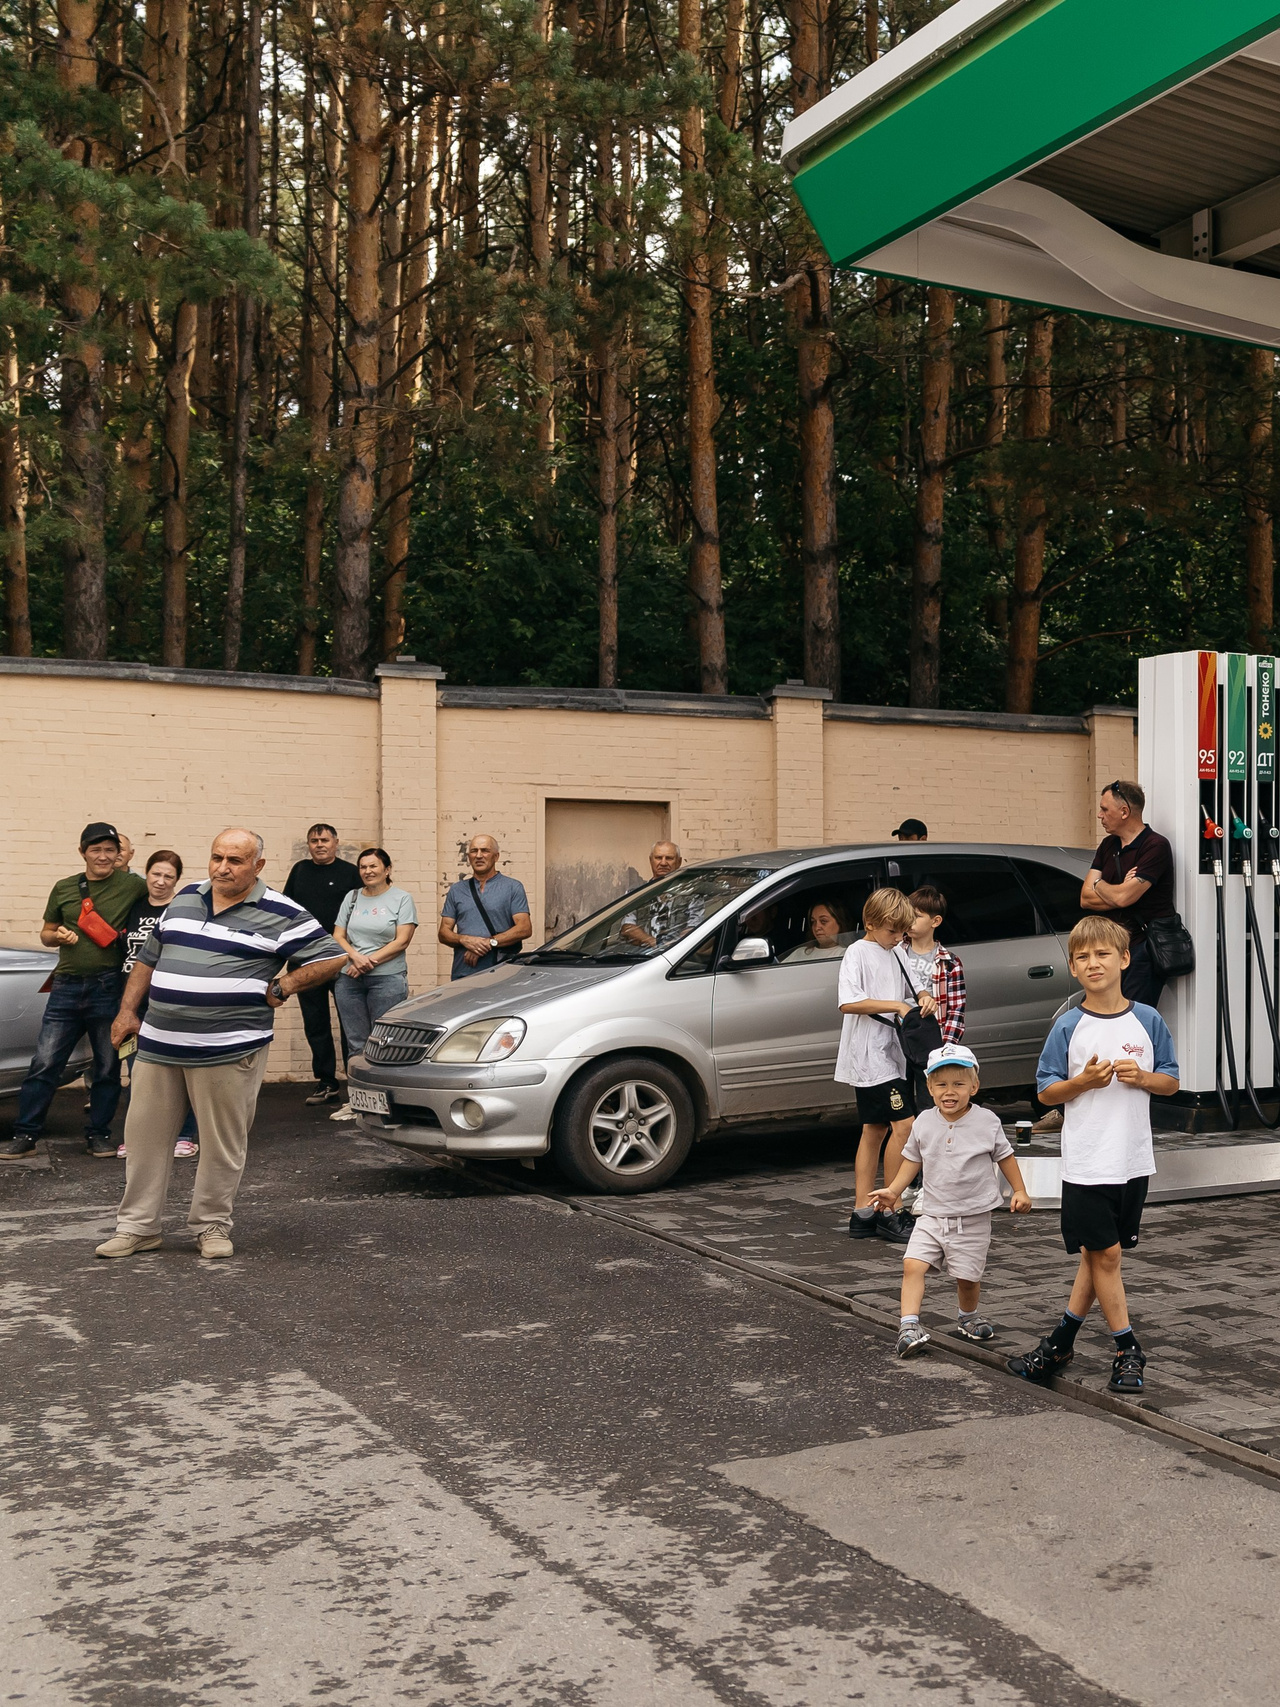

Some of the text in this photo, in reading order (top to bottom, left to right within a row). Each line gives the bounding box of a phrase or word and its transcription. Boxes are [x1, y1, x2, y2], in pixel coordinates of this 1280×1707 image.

[1199, 749, 1216, 764] 95
[1228, 750, 1245, 765] 92
[1257, 752, 1275, 767] ДТ
